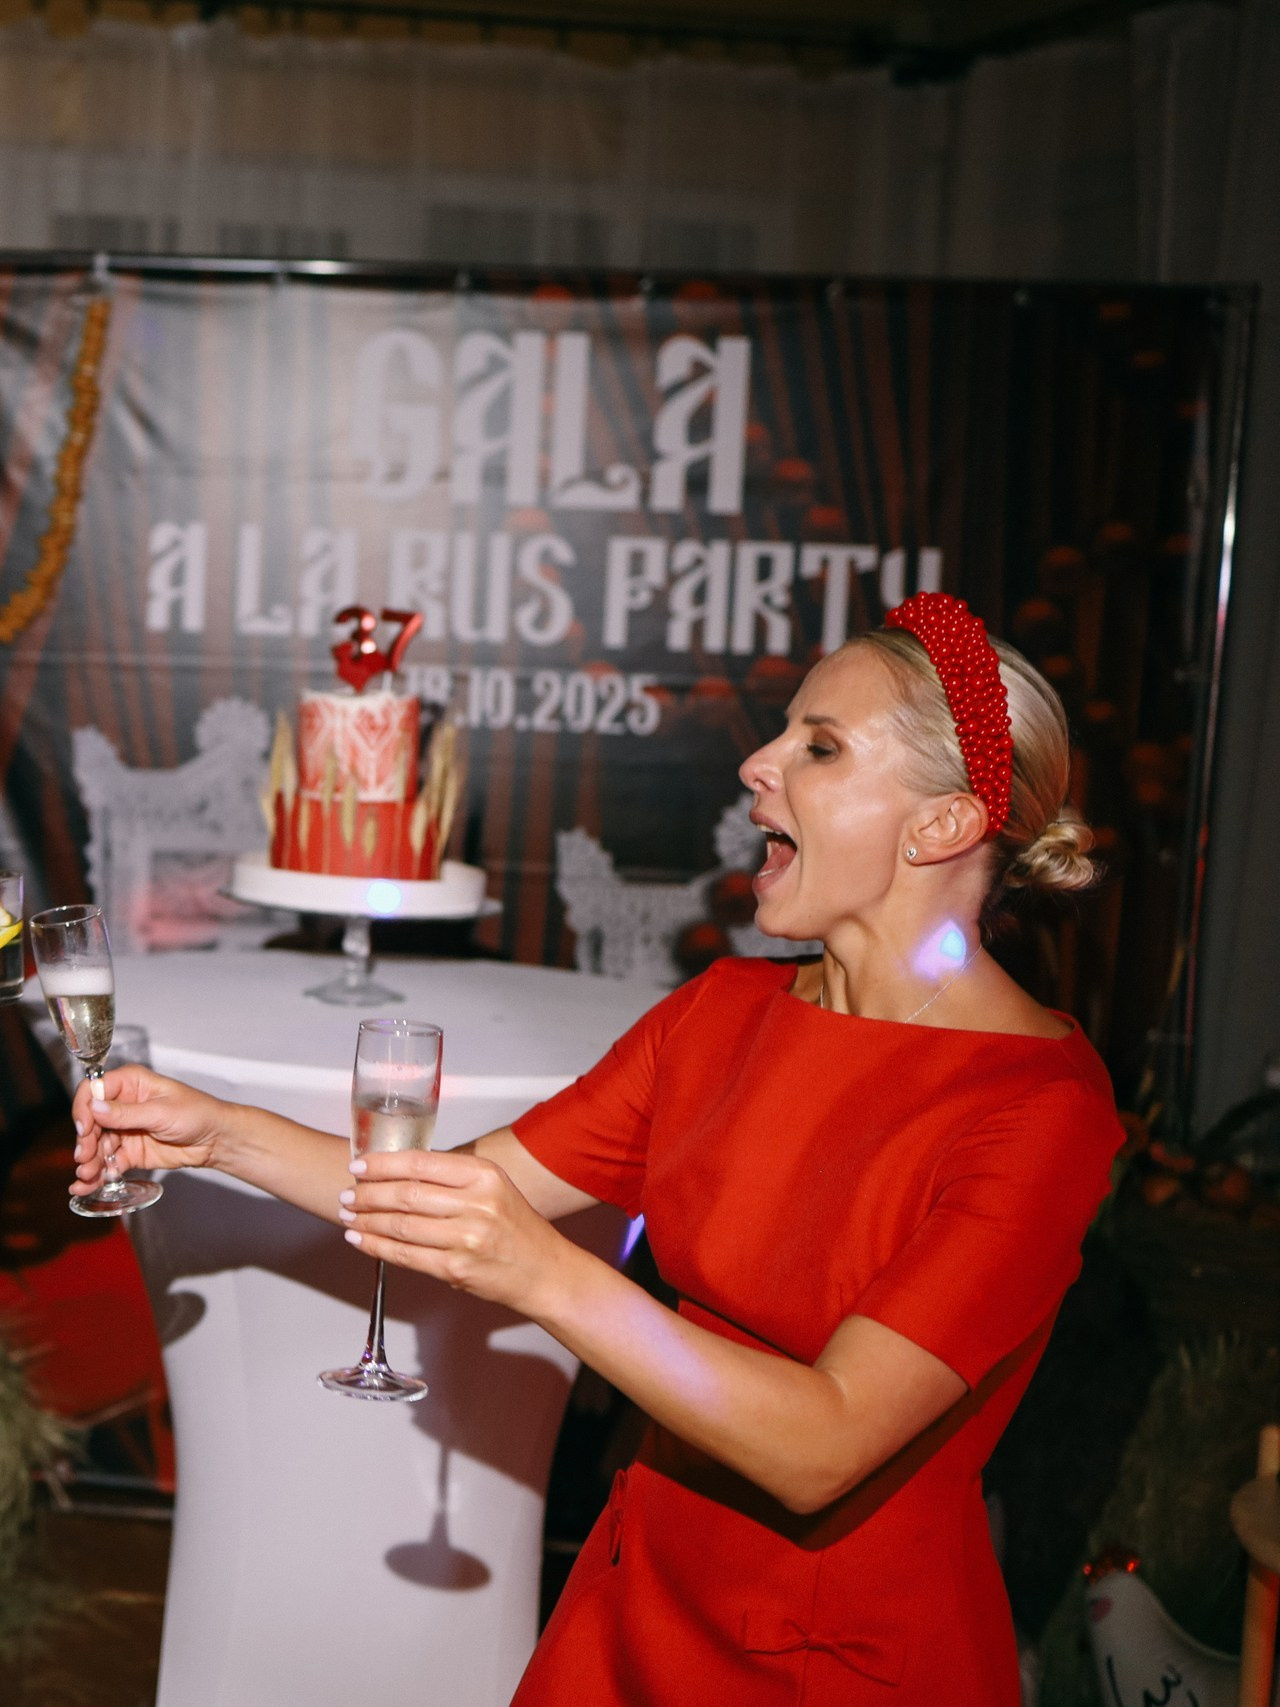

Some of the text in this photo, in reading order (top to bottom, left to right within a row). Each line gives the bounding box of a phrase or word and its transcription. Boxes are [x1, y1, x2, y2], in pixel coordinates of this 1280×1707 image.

[351, 329, 751, 514] GALA
[146, 521, 206, 633] A
[235, 523, 357, 637] LA
[387, 529, 576, 646] RUS
